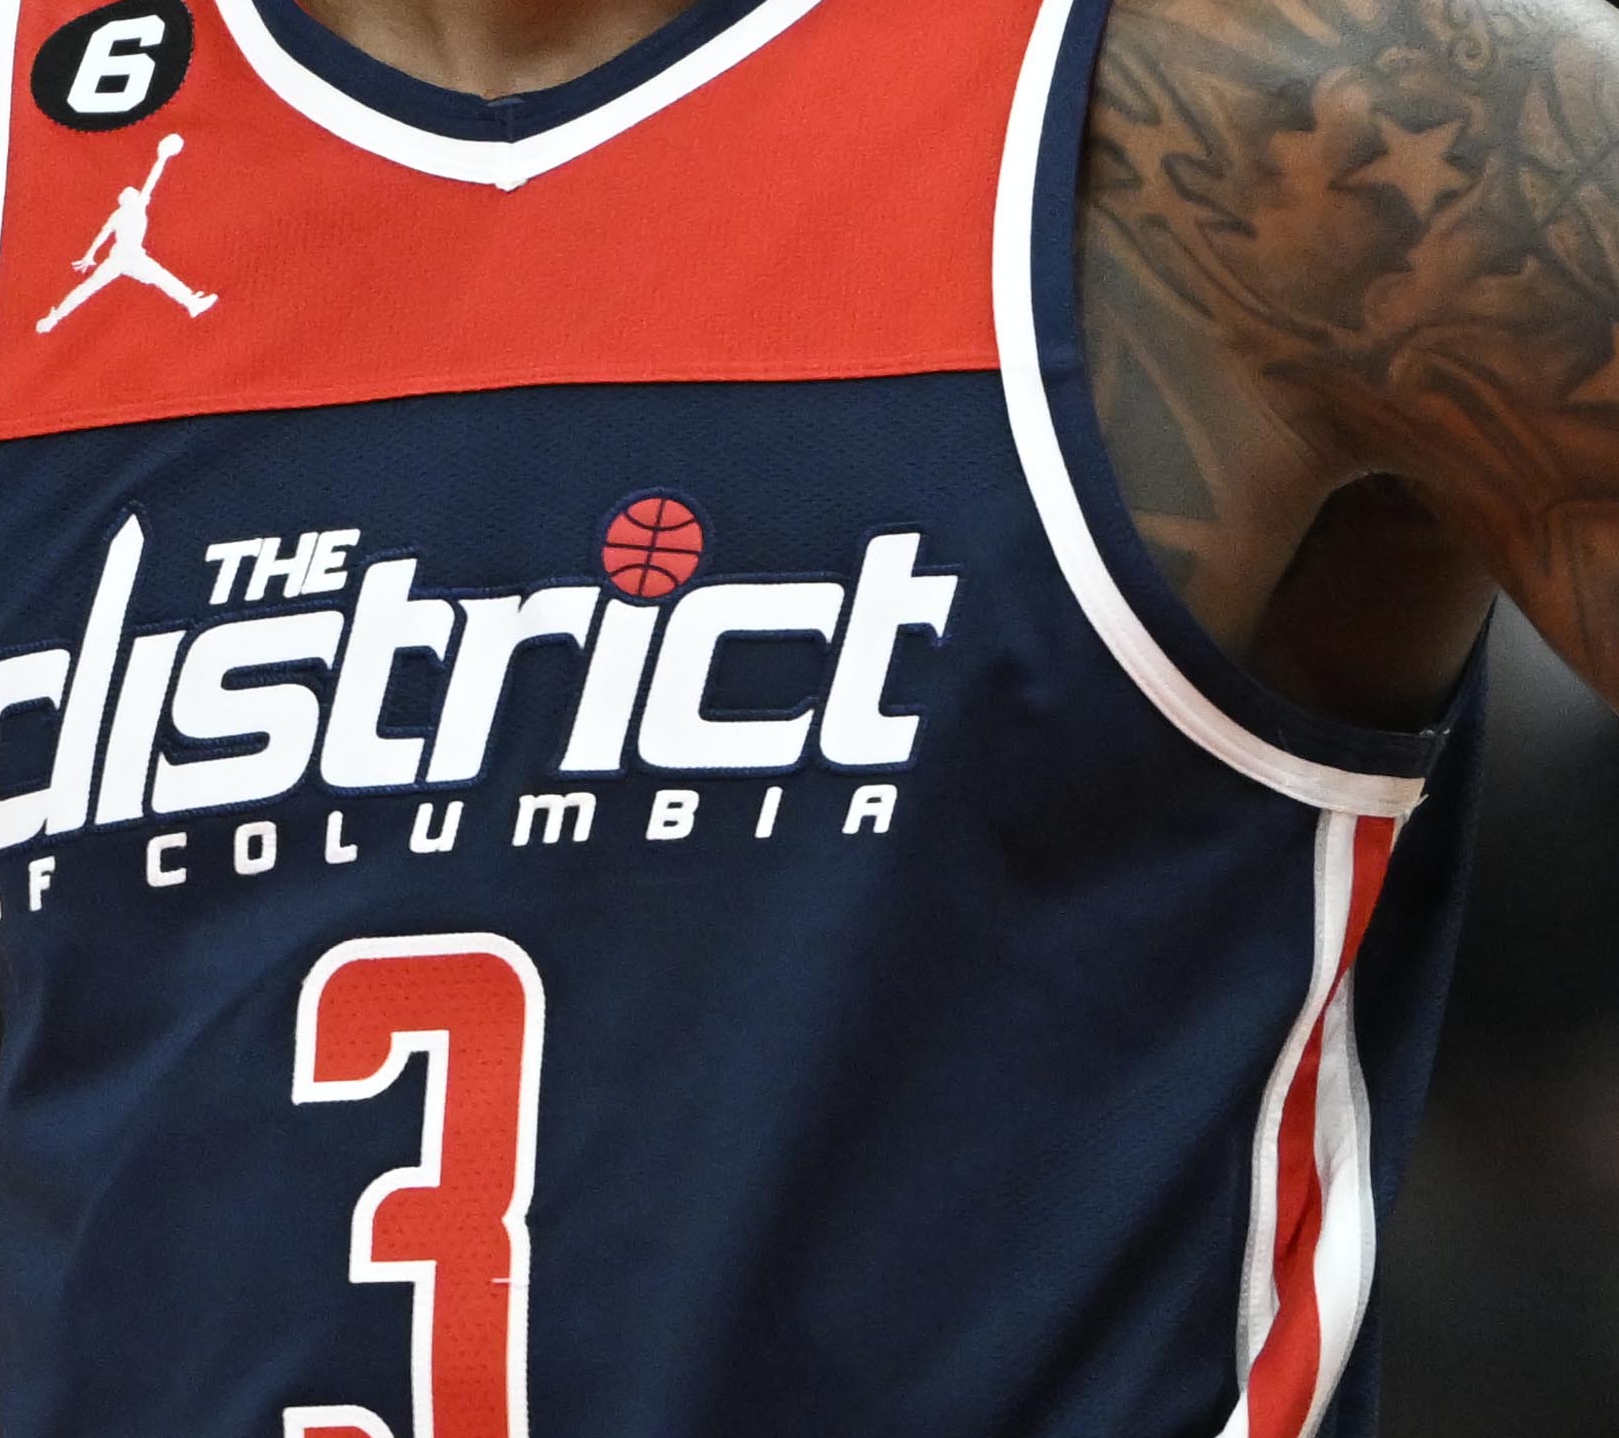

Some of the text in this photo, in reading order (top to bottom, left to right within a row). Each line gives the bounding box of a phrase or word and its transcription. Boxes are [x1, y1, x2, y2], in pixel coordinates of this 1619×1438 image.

[66, 14, 166, 114] 6
[204, 527, 361, 606] THE
[146, 783, 899, 888] COLUMBIA
